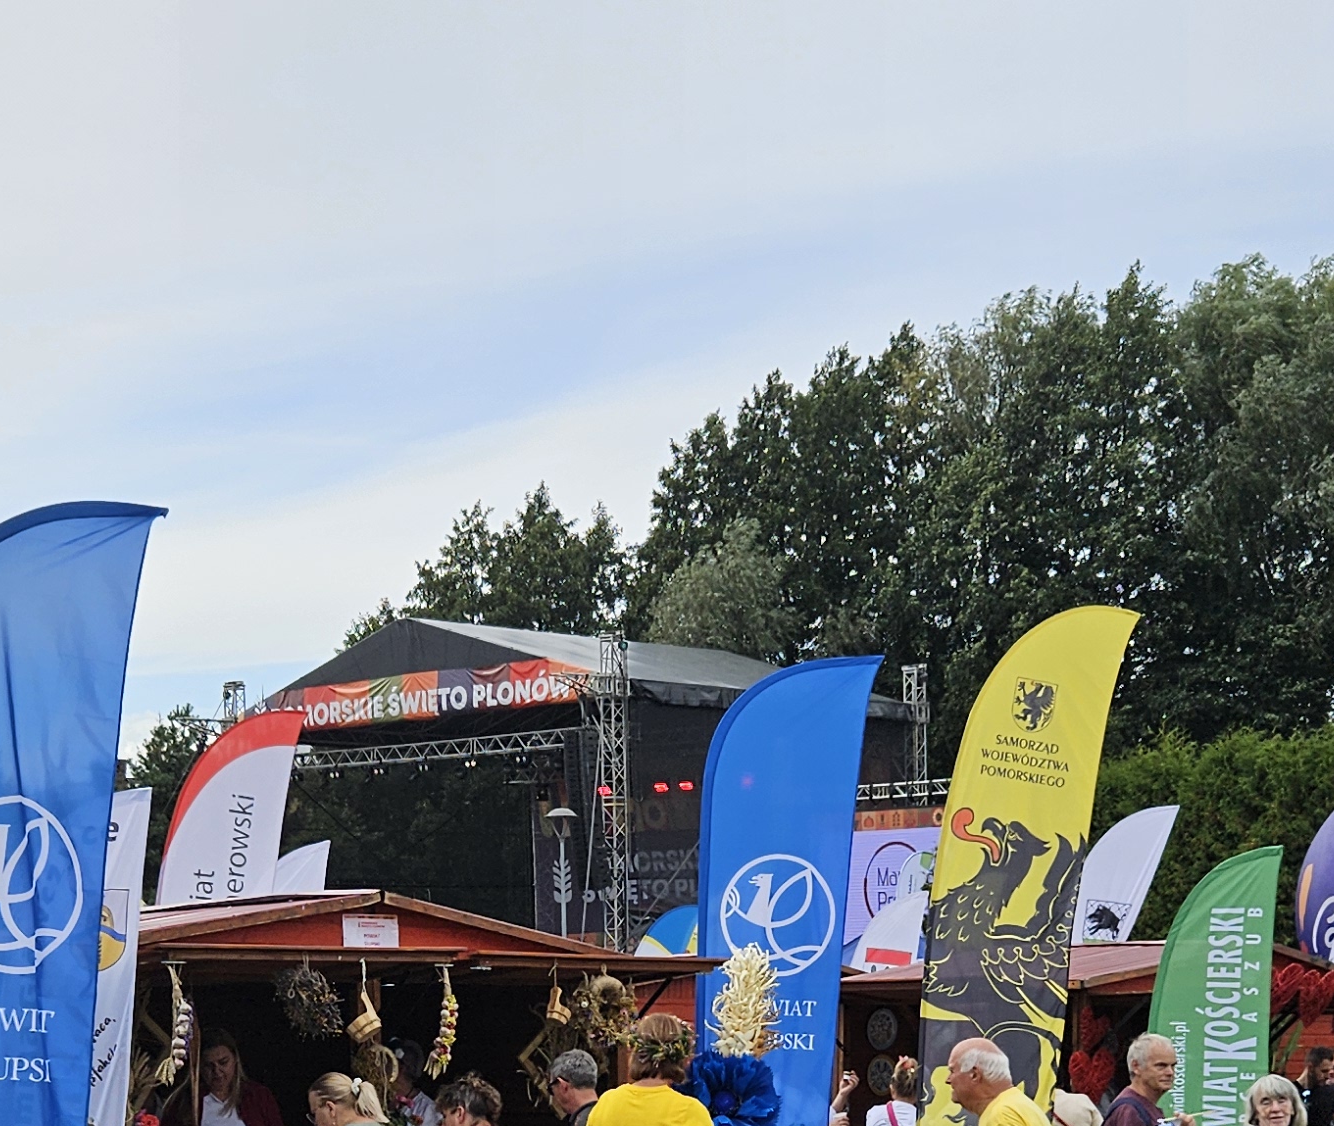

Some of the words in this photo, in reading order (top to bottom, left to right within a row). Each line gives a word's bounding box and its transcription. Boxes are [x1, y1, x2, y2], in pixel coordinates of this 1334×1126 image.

[388, 685, 467, 718] ŚWIĘTO
[472, 669, 569, 709] PLONÓW
[996, 734, 1059, 755] SAMORZĄD
[981, 748, 1069, 772] WOJEWÓDZTWA
[980, 764, 1066, 788] POMORSKIEGO
[227, 794, 255, 899] erowski
[189, 869, 215, 900] iat
